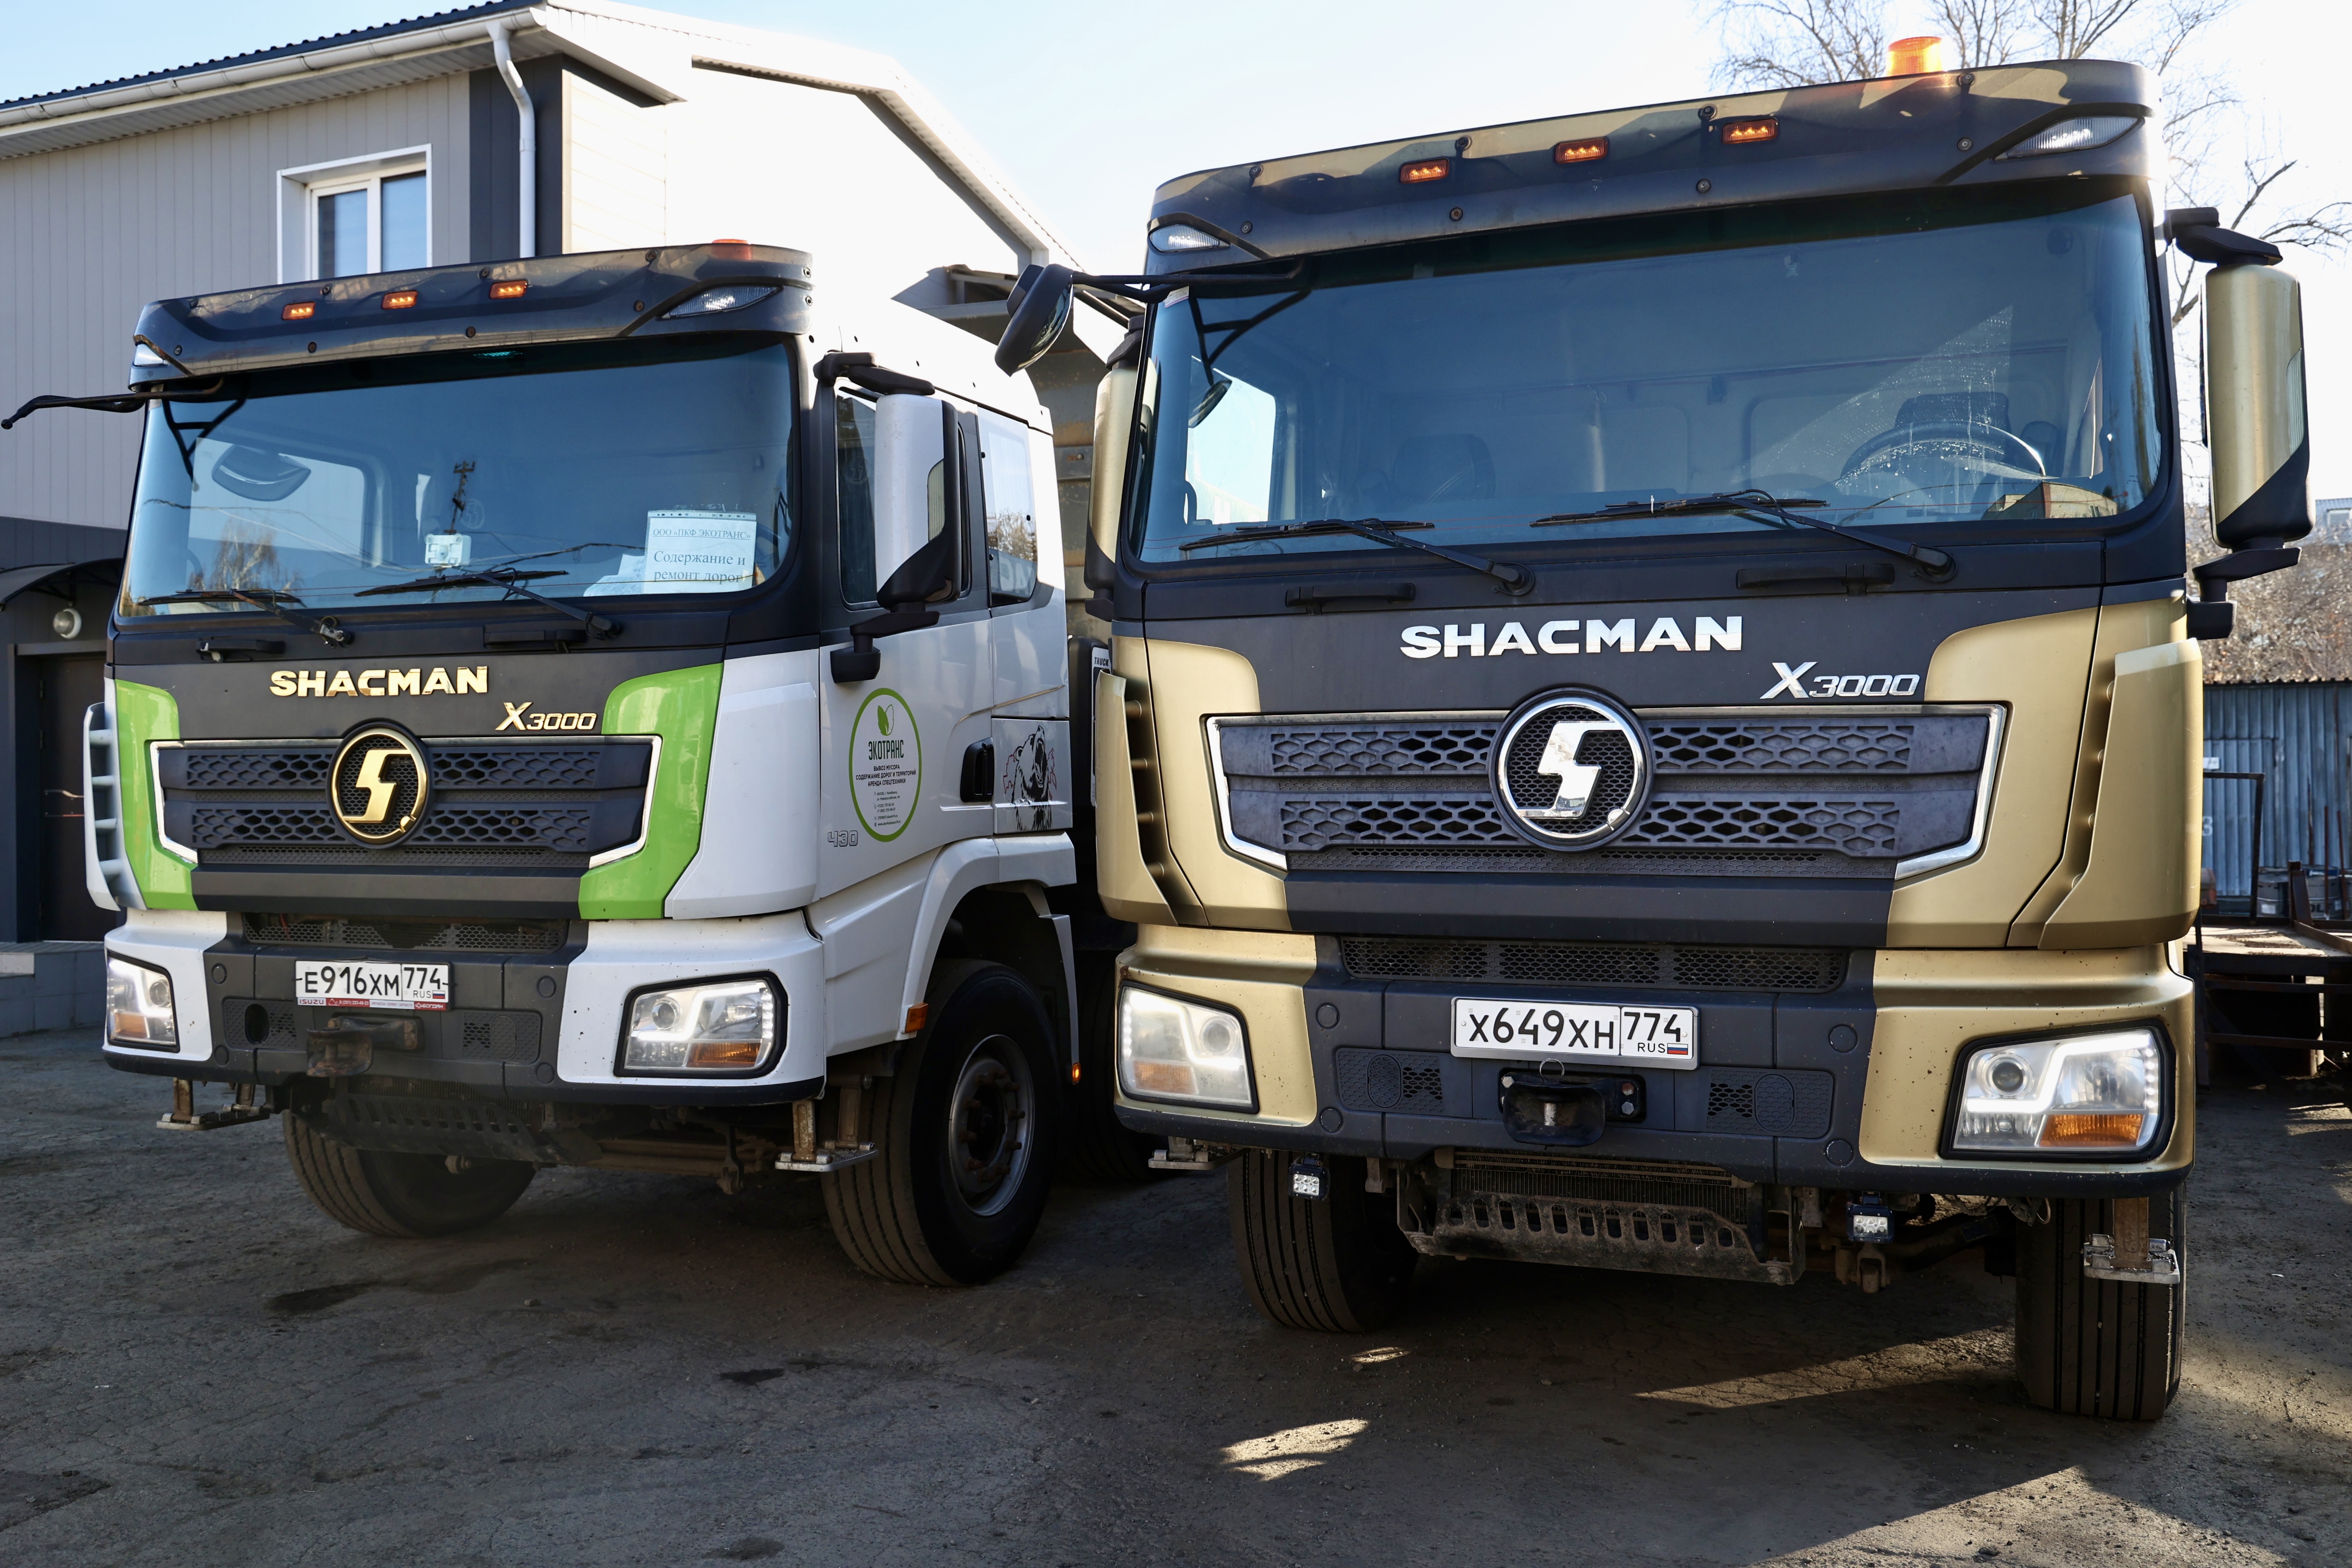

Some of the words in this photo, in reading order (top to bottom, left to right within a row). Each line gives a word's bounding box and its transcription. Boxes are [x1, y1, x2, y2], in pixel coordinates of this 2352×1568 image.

[698, 530, 750, 539] ЭКОТРАНС»
[654, 551, 733, 565] Содержание
[738, 557, 745, 566] и
[654, 571, 699, 582] ремонт
[703, 573, 742, 585] дорог
[1400, 616, 1742, 658] SHACMAN
[1094, 657, 1109, 667] TRUCK
[270, 666, 488, 697] SHACMAN
[1759, 661, 1920, 699] X3000
[495, 701, 597, 731] X3000
[868, 739, 904, 760] ЭКОТРАНС
[827, 830, 858, 847] 430
[305, 965, 399, 996] Е916ХМ
[404, 967, 441, 989] 774
[413, 990, 432, 998] RUS
[1469, 1007, 1614, 1050] Х649ХН
[1624, 1011, 1681, 1042] 774
[1637, 1042, 1666, 1054] RUS
